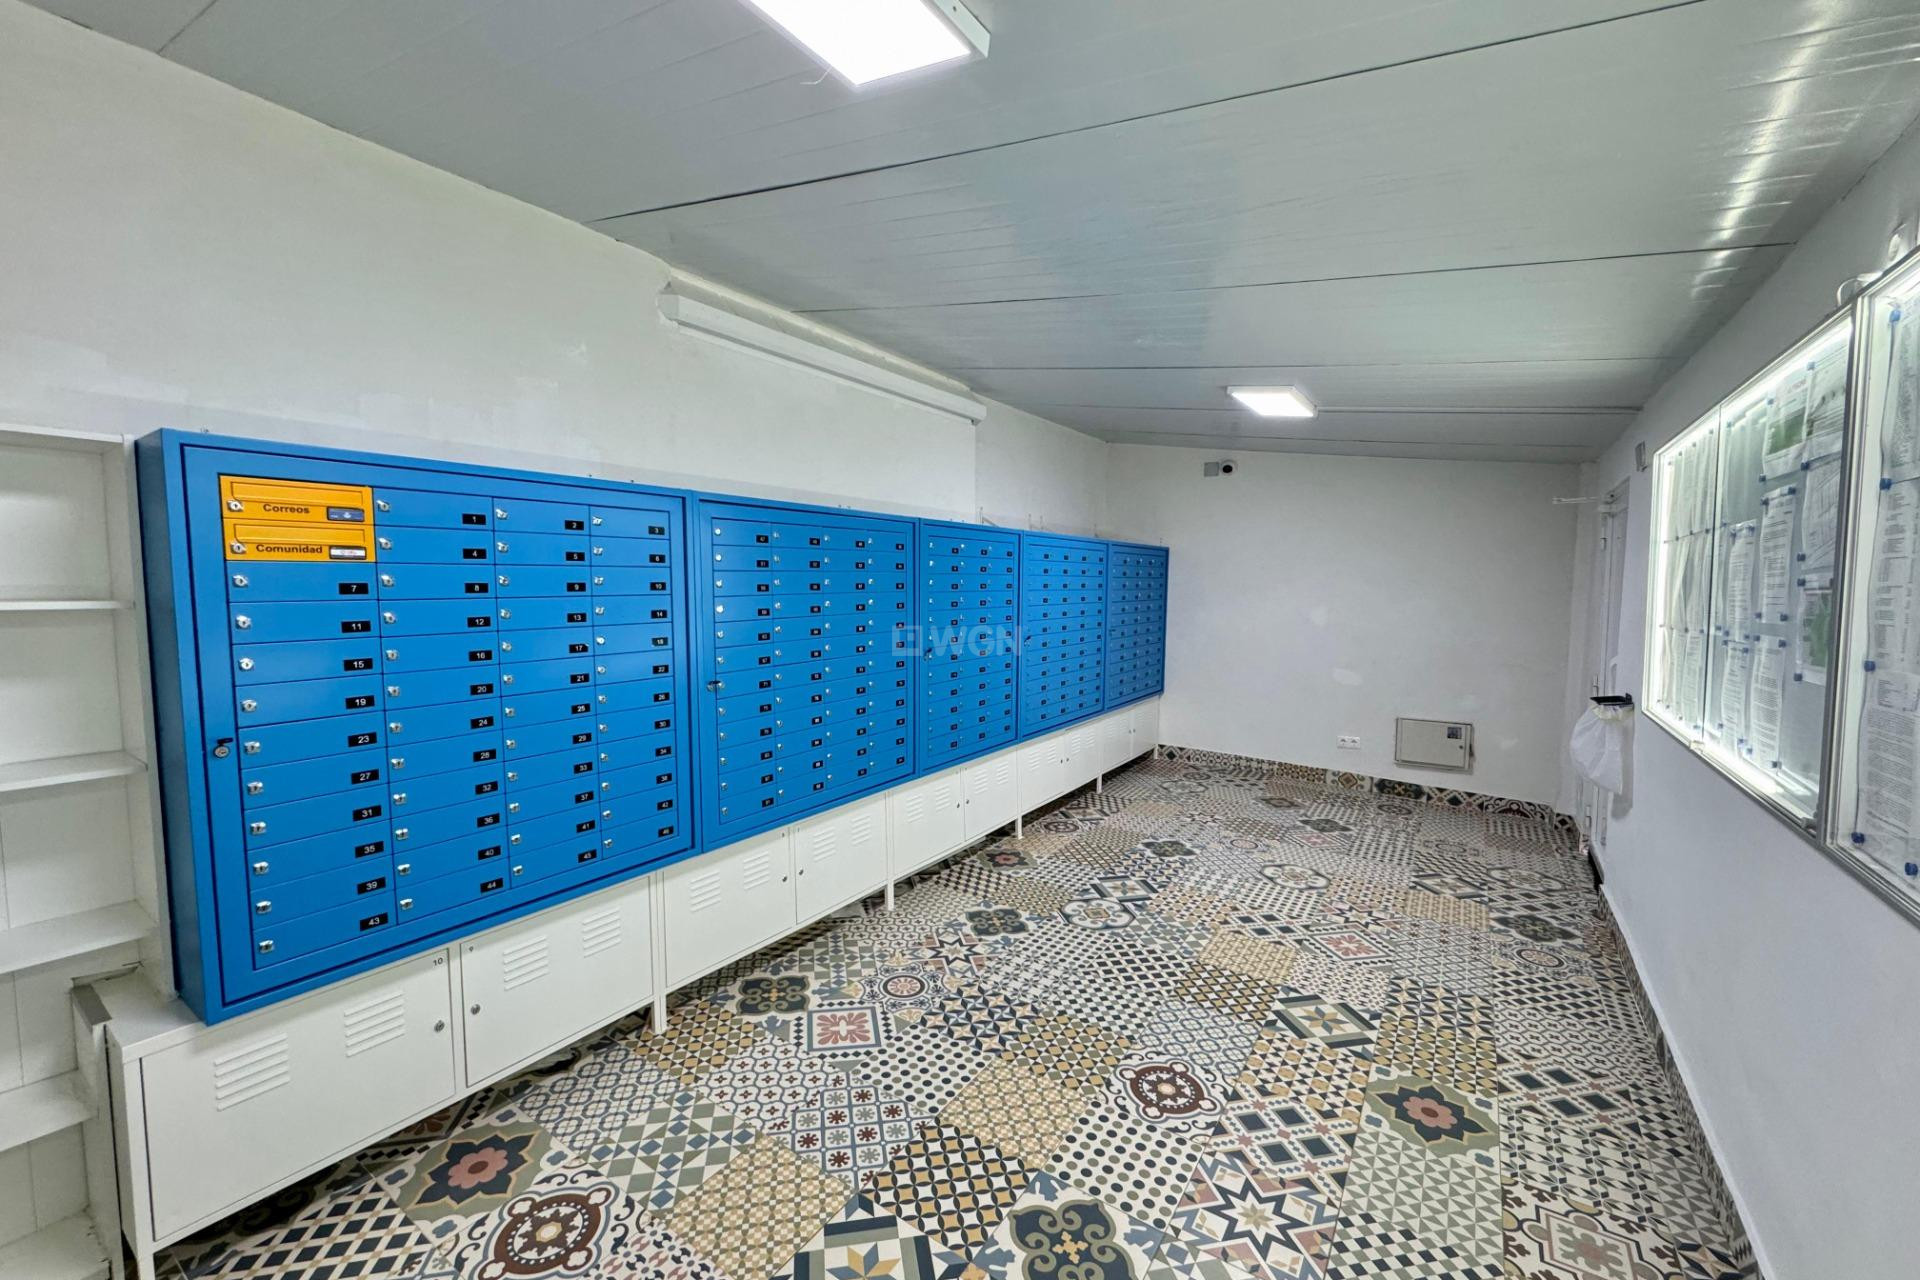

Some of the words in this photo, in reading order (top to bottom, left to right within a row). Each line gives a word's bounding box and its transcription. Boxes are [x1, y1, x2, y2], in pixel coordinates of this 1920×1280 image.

[263, 503, 310, 514] Correos
[256, 543, 323, 554] Comunidad
[351, 585, 357, 593] 7
[353, 660, 365, 668] 15
[355, 698, 367, 706] 19
[358, 735, 370, 744] 23
[359, 772, 371, 781] 27
[362, 809, 372, 818] 31
[364, 845, 376, 854] 35
[366, 881, 378, 891] 39
[368, 917, 380, 925] 43
[433, 957, 444, 966] 10
